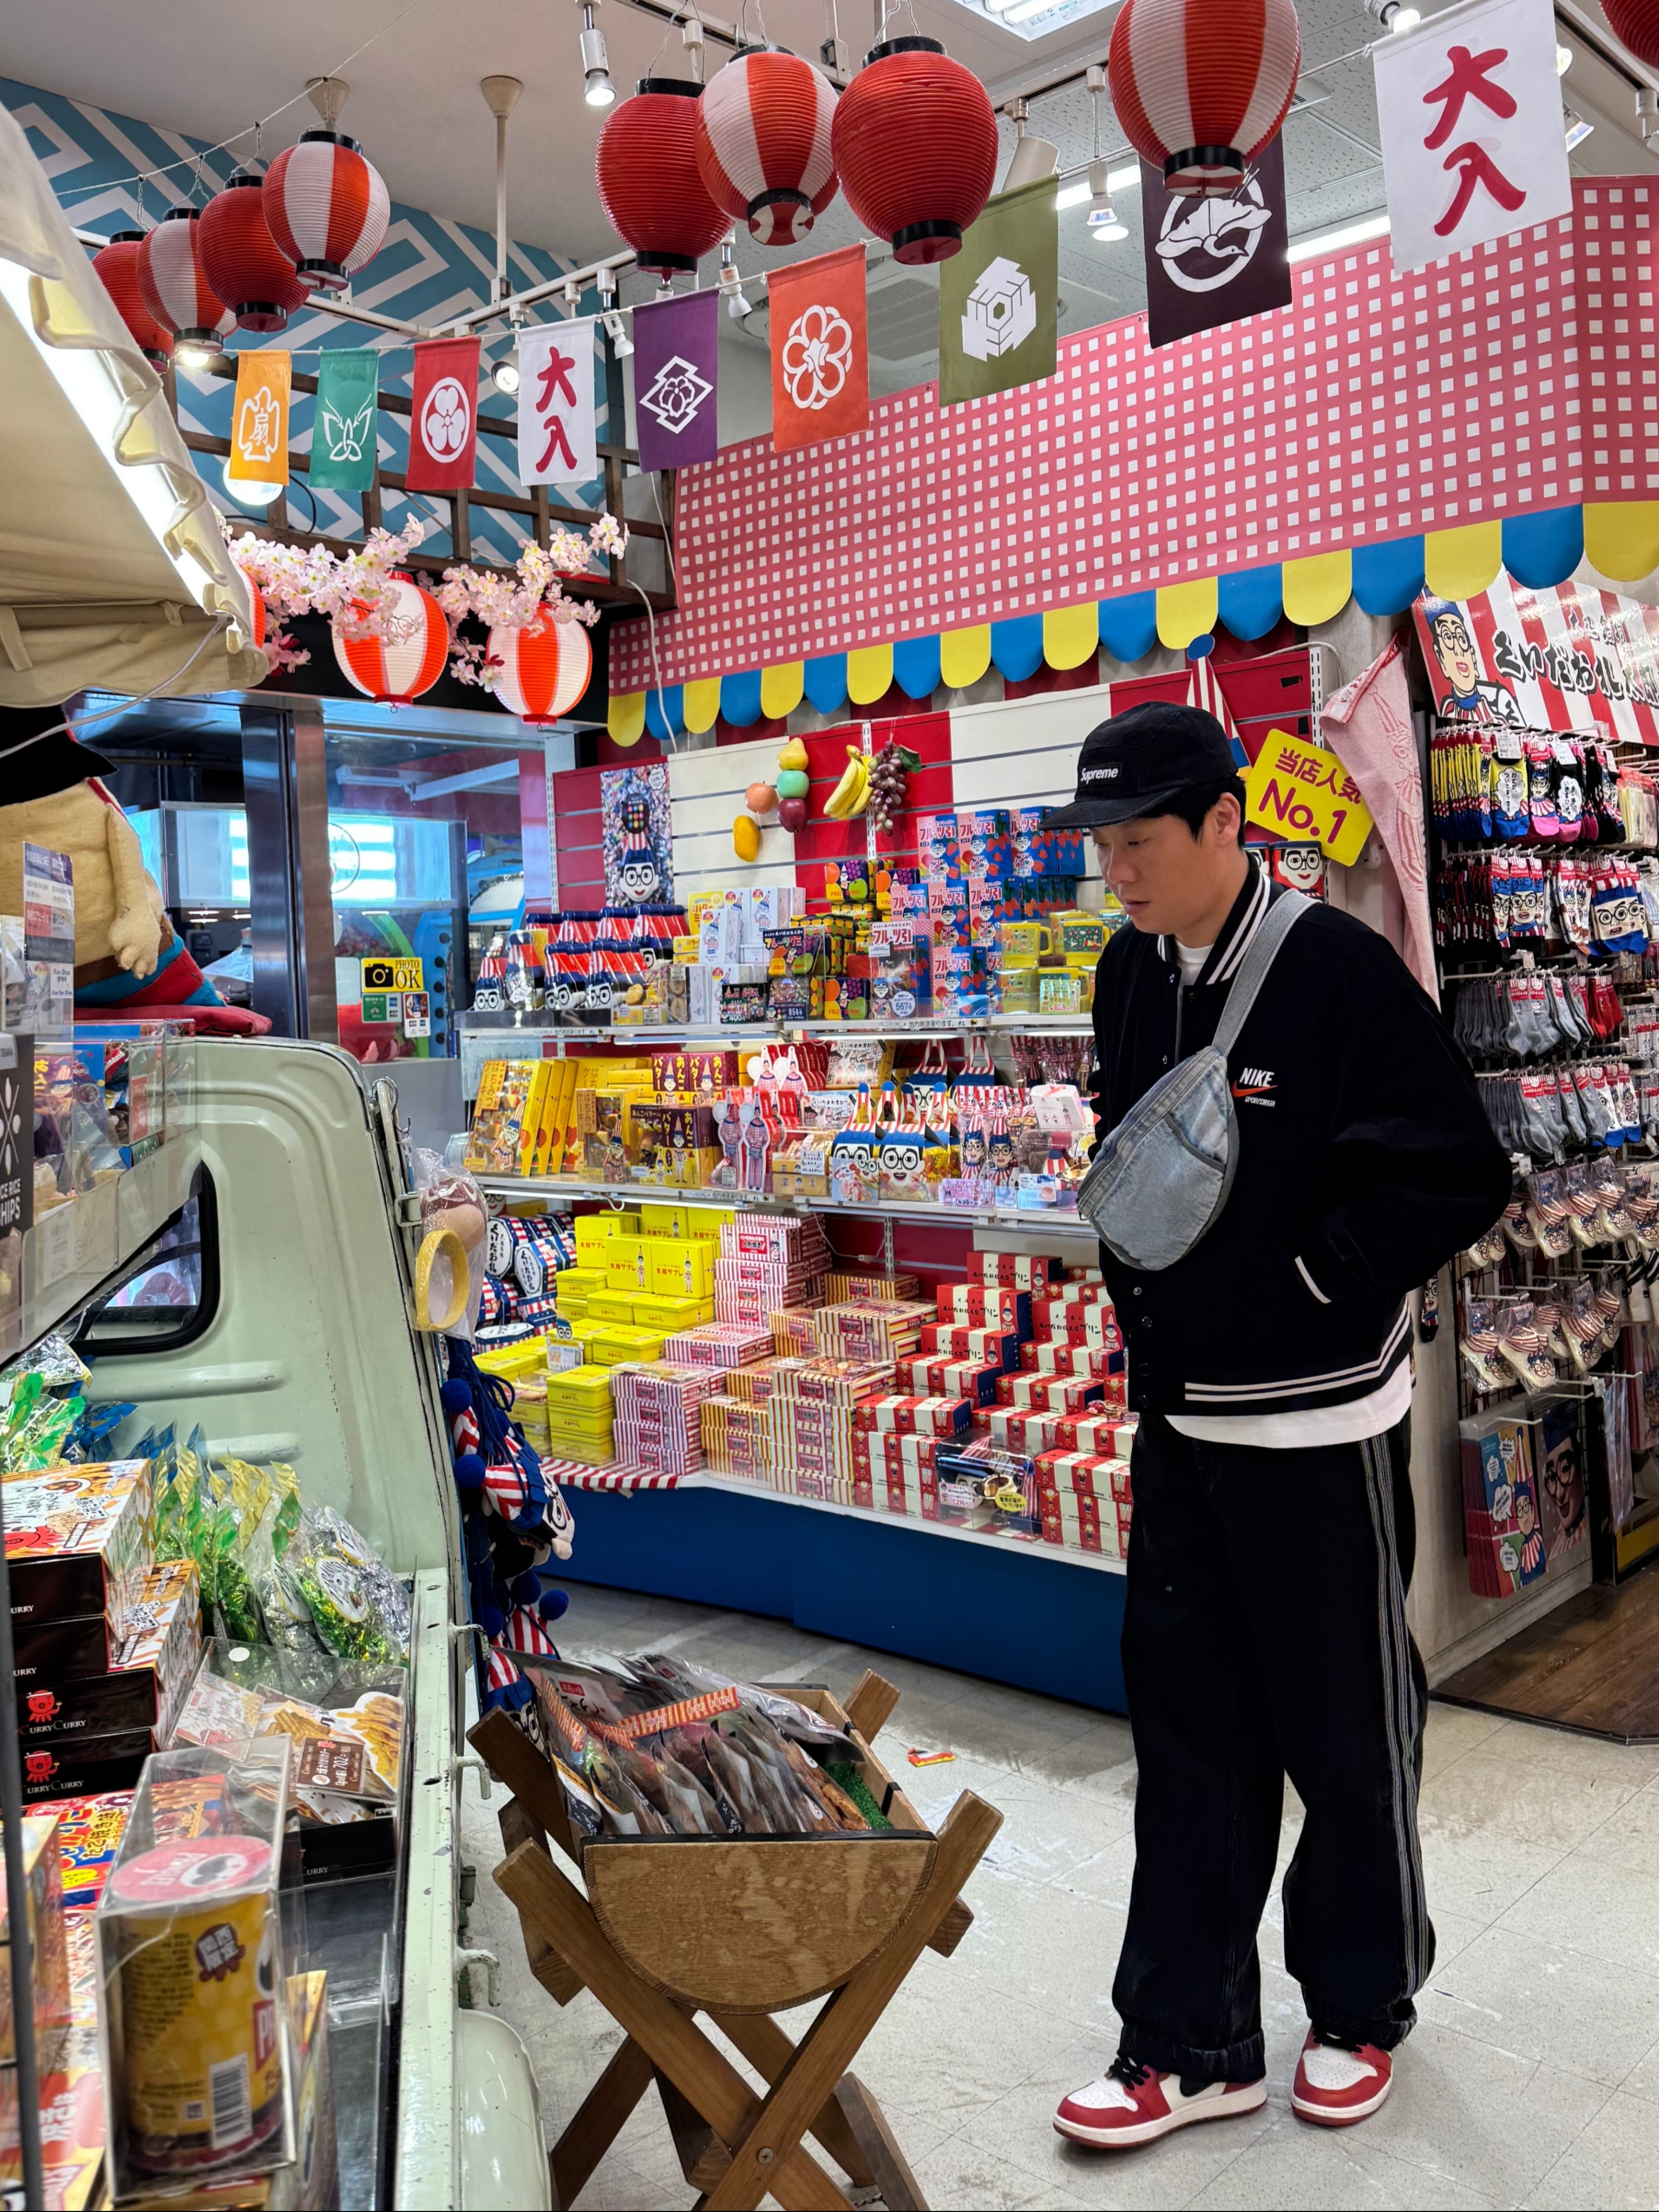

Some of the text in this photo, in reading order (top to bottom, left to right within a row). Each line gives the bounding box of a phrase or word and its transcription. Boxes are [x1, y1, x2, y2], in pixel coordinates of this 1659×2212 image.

[1422, 45, 1527, 237] 大入
[535, 346, 578, 474] 大入
[1081, 767, 1118, 785] Supreme
[1258, 778, 1347, 844] No.1
[395, 960, 419, 969] PHOTO
[395, 969, 421, 989] OK
[1, 1048, 13, 1056] OSAKA
[479, 1062, 492, 1096] ケーキ
[485, 1062, 499, 1107] はちみつ
[654, 1056, 664, 1090] バター
[676, 1056, 686, 1090] あんこ
[690, 1056, 700, 1090] バター
[713, 1055, 723, 1090] あんこ
[1239, 1067, 1274, 1087] NIKE
[663, 1112, 671, 1146] バター
[684, 1112, 693, 1147] あんこ
[10, 1605, 34, 1614] URRY
[13, 1667, 37, 1677] URRY
[81, 1811, 114, 1859] たこ焼き味
